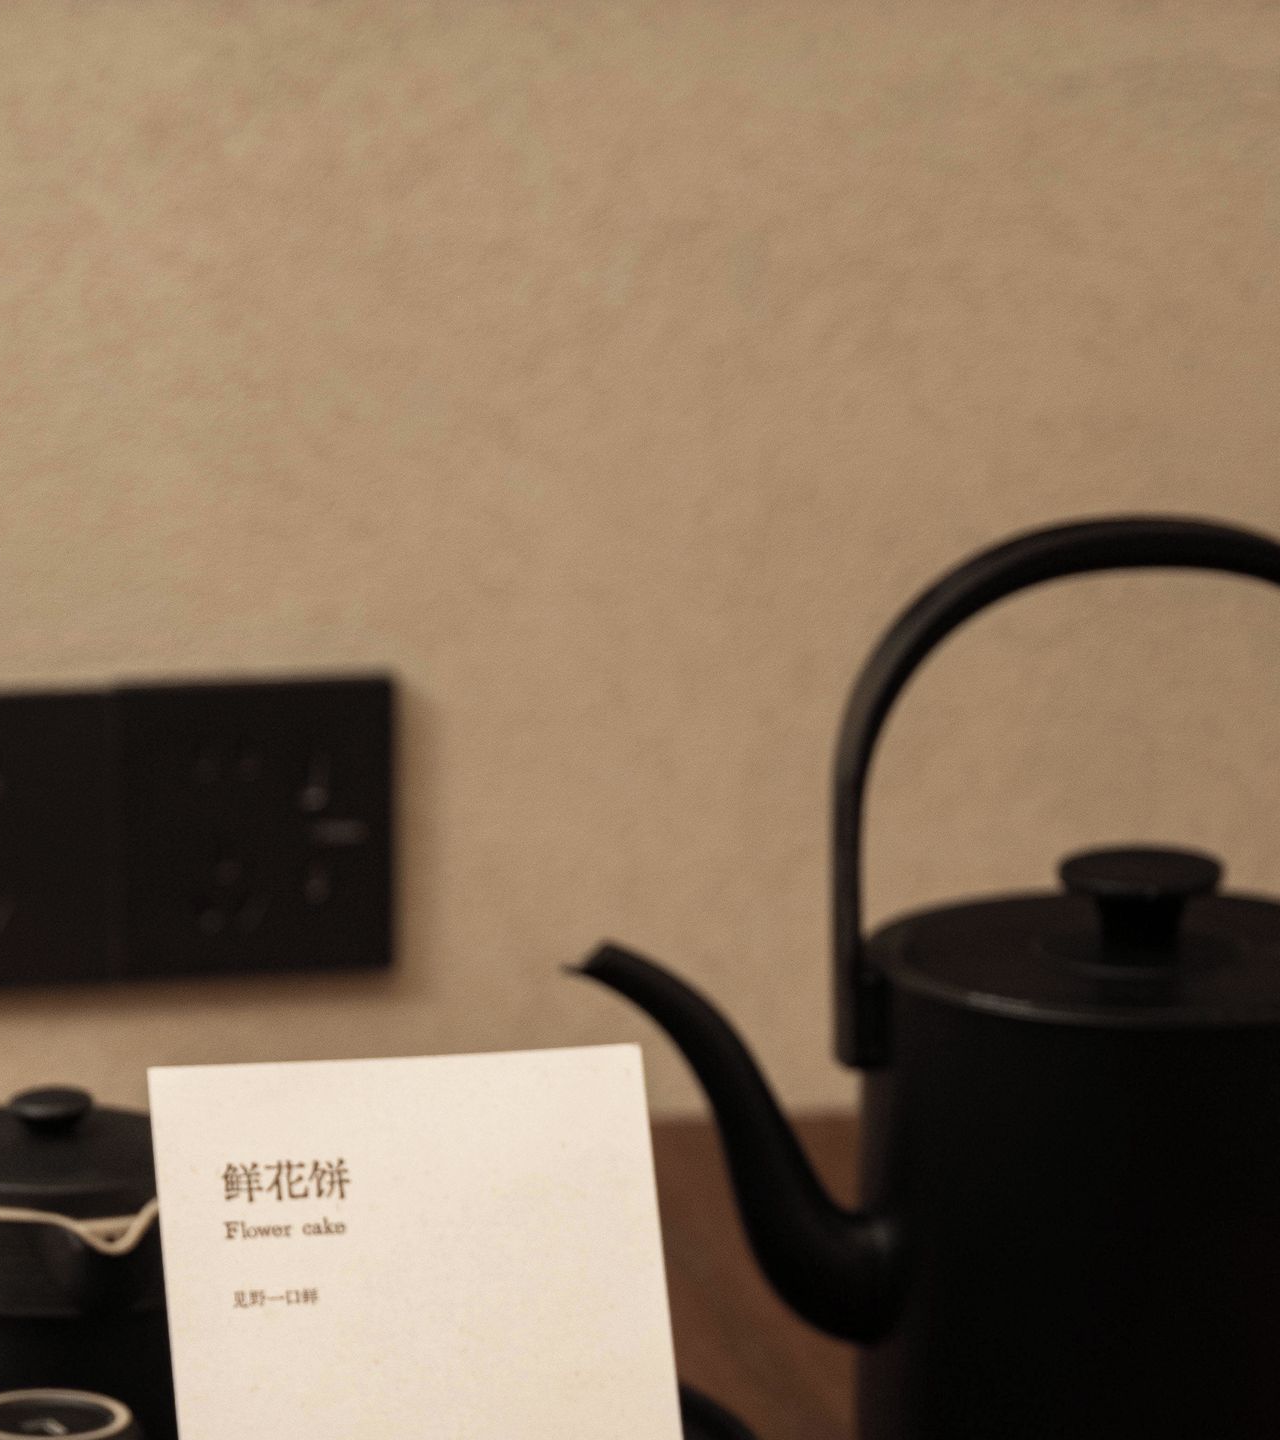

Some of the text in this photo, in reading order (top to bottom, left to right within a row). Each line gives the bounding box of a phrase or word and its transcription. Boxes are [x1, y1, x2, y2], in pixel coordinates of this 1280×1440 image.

[222, 1158, 351, 1202] 鲜花饼
[223, 1216, 347, 1240] Flower cake
[233, 1287, 320, 1309] 见野一口鲜
